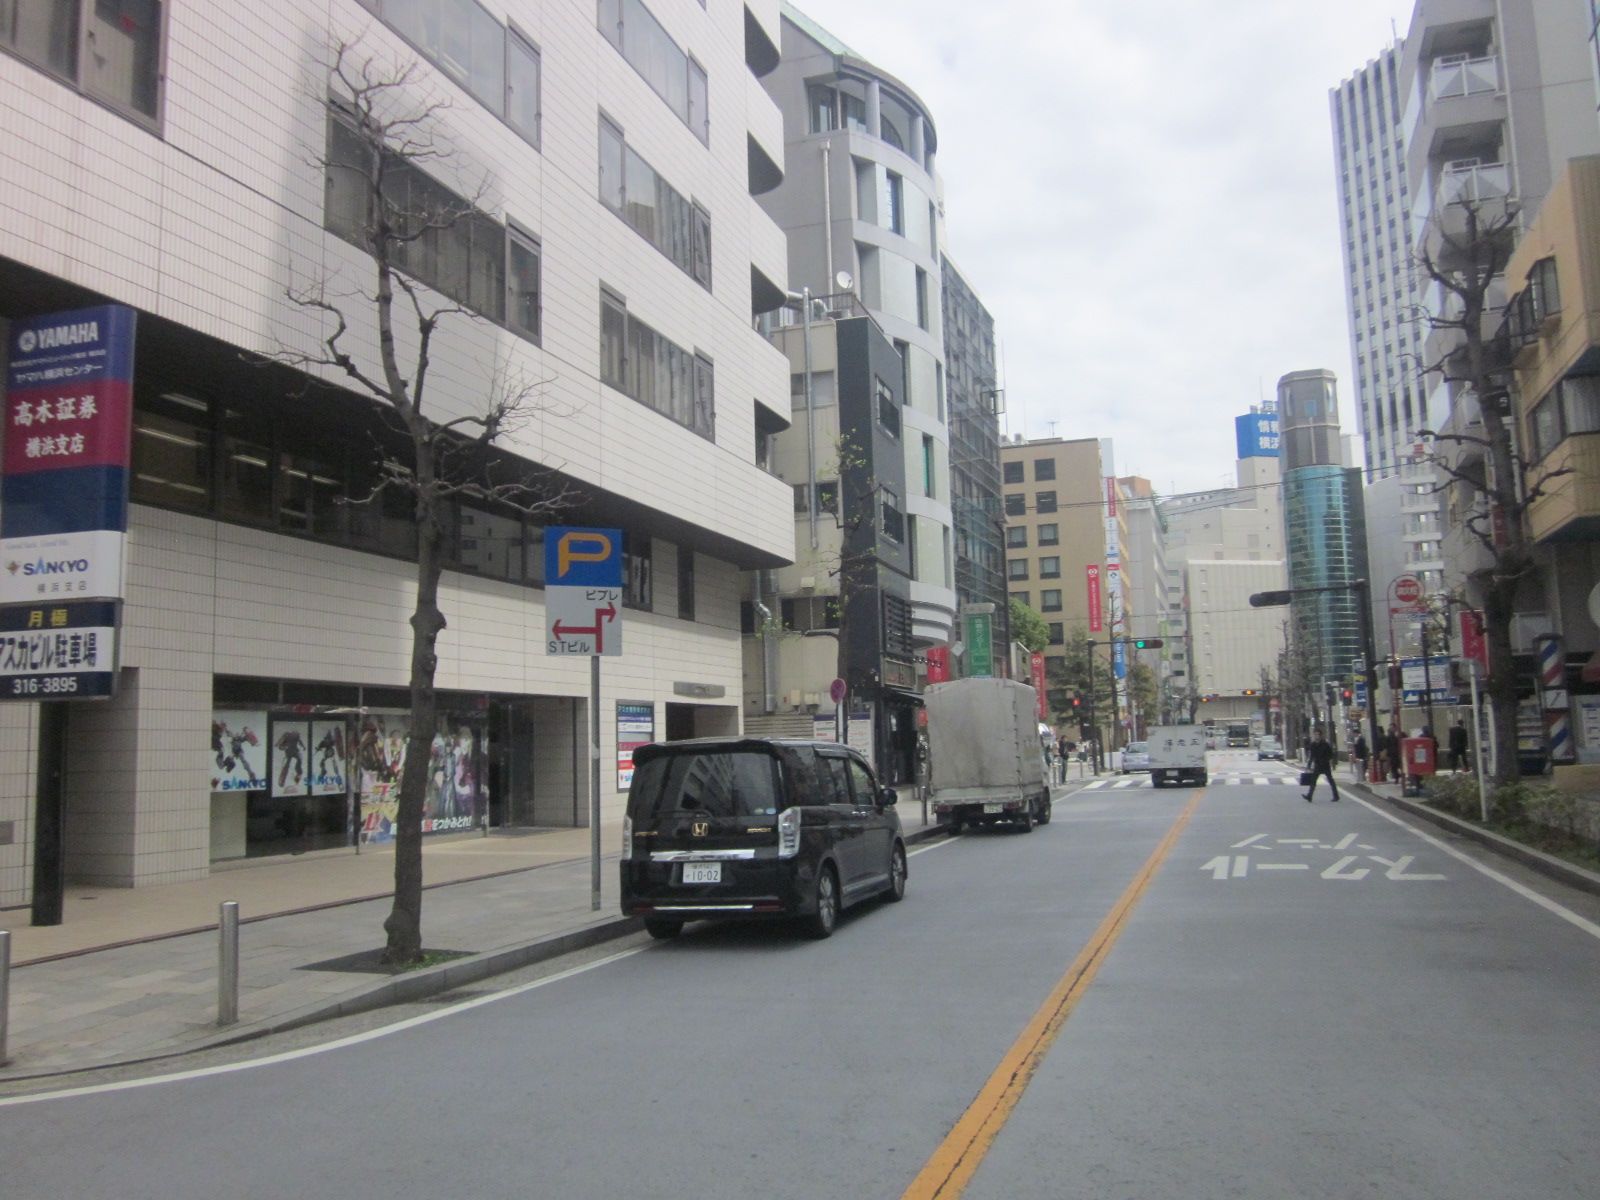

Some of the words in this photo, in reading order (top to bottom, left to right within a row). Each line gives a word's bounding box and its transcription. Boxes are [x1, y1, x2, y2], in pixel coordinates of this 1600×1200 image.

[38, 321, 98, 350] YAMAHA
[14, 395, 98, 427] 高木証券
[25, 433, 85, 458] 横浜支店
[23, 556, 88, 576] SANKYO
[558, 531, 611, 578] P
[13, 677, 77, 694] 316-3895
